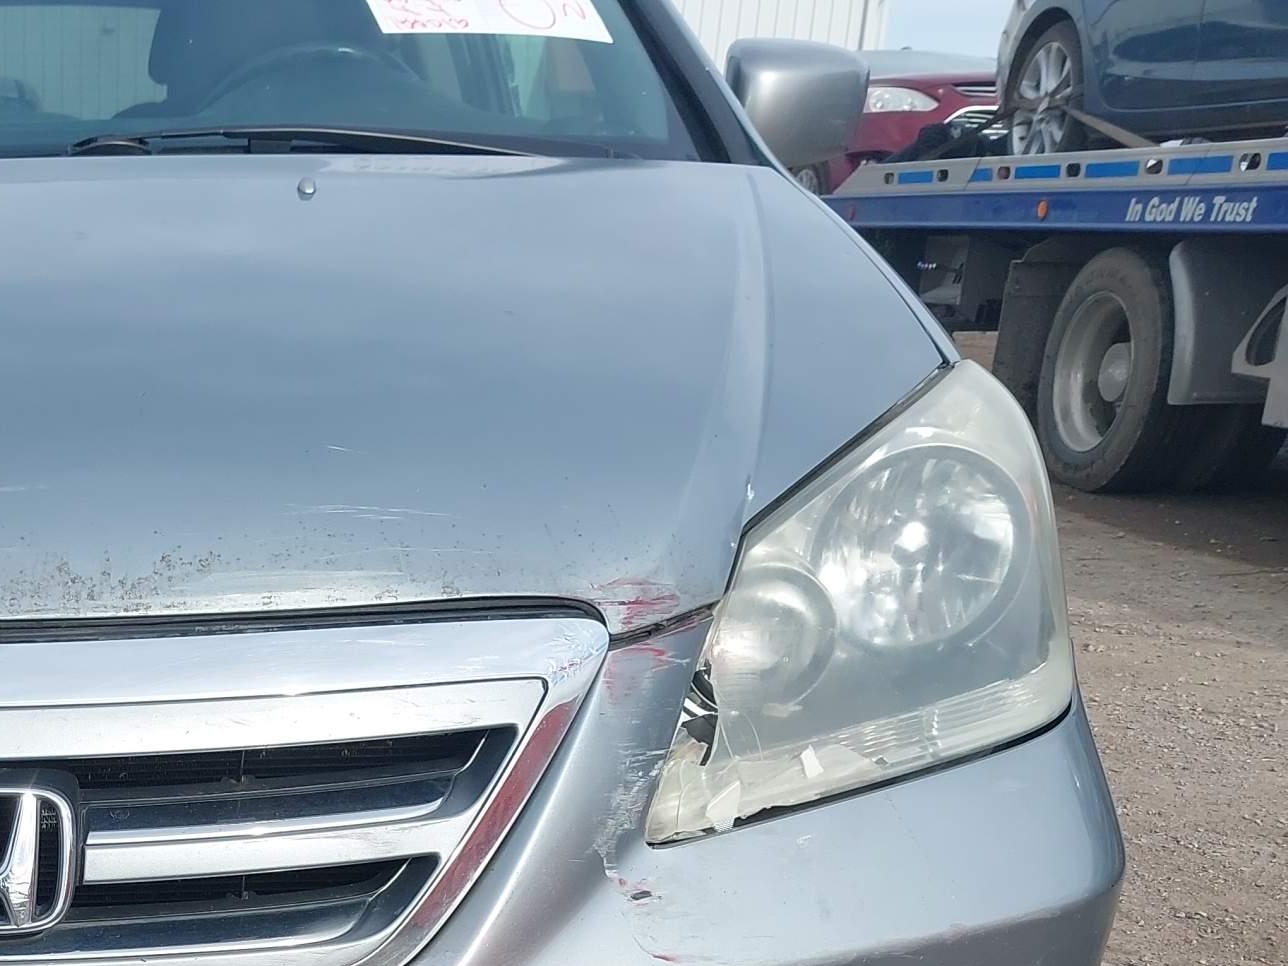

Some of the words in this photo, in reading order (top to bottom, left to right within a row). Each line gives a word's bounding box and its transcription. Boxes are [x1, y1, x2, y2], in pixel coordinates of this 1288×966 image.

[1125, 197, 1144, 222] In
[1144, 196, 1181, 222] God
[1179, 196, 1207, 222] We
[1209, 195, 1258, 222] Trust
